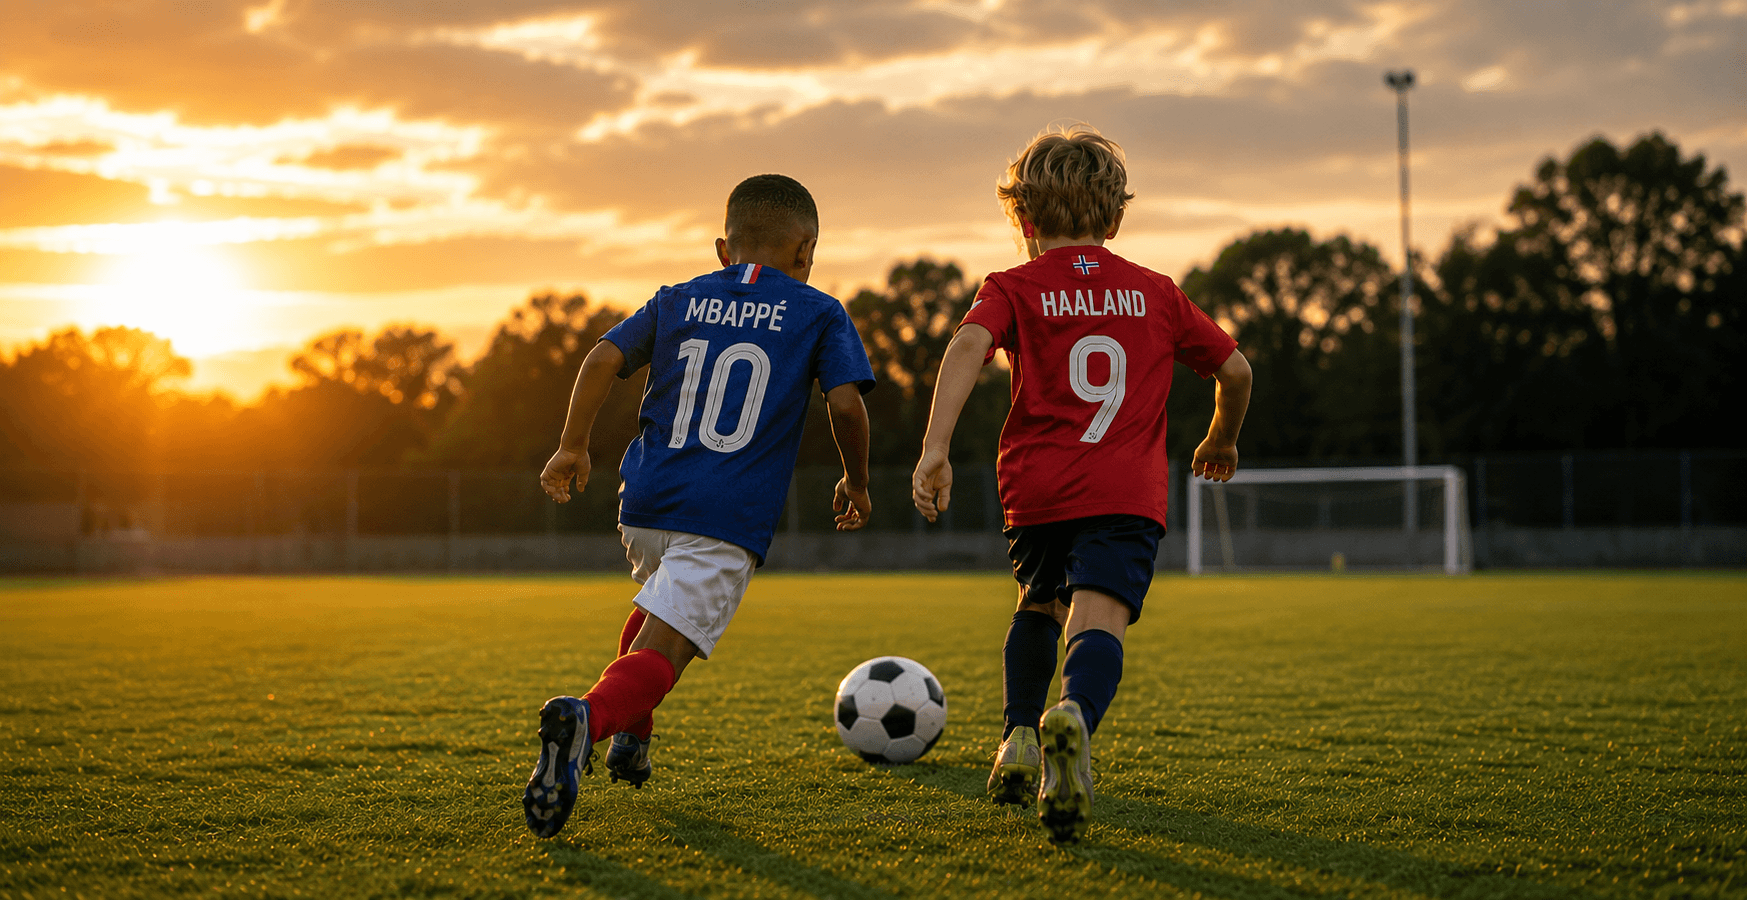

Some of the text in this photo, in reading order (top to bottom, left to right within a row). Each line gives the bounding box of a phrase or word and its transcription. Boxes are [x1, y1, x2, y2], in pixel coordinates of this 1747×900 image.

[684, 297, 787, 332] MBAPPÉ
[1040, 289, 1146, 317] HAALAND
[667, 338, 771, 453] 10
[1069, 335, 1127, 444] 9
